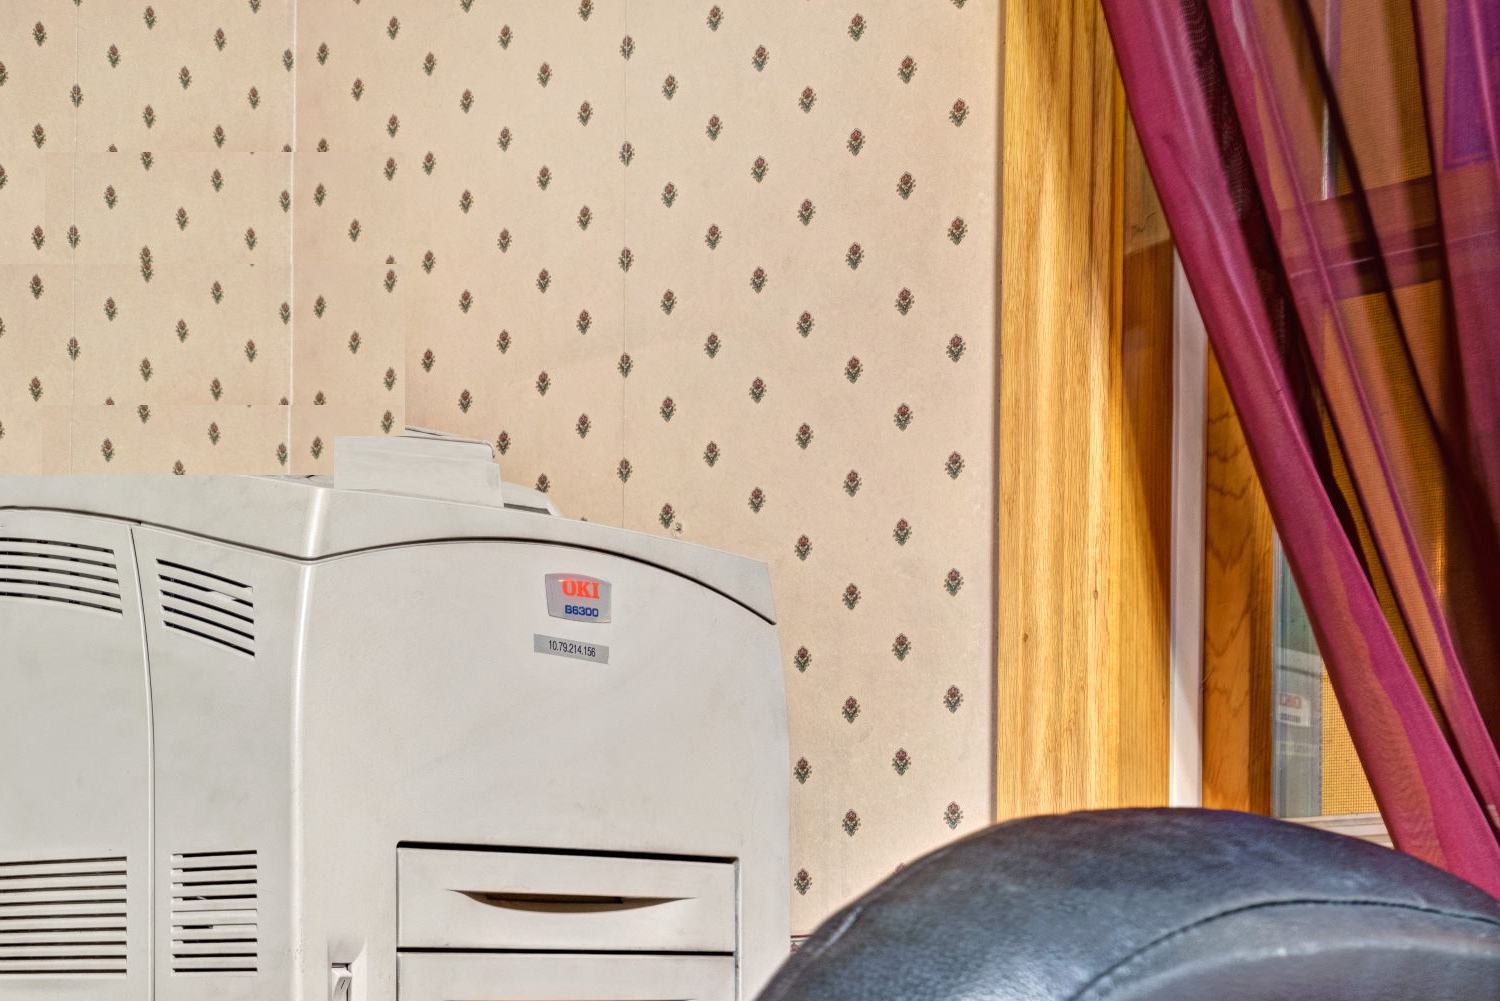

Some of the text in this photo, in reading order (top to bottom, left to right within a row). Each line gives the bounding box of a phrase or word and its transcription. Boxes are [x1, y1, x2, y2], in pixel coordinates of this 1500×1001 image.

[562, 578, 600, 599] OKI
[565, 605, 599, 617] B6300
[548, 640, 596, 657] 10.79.214.156
